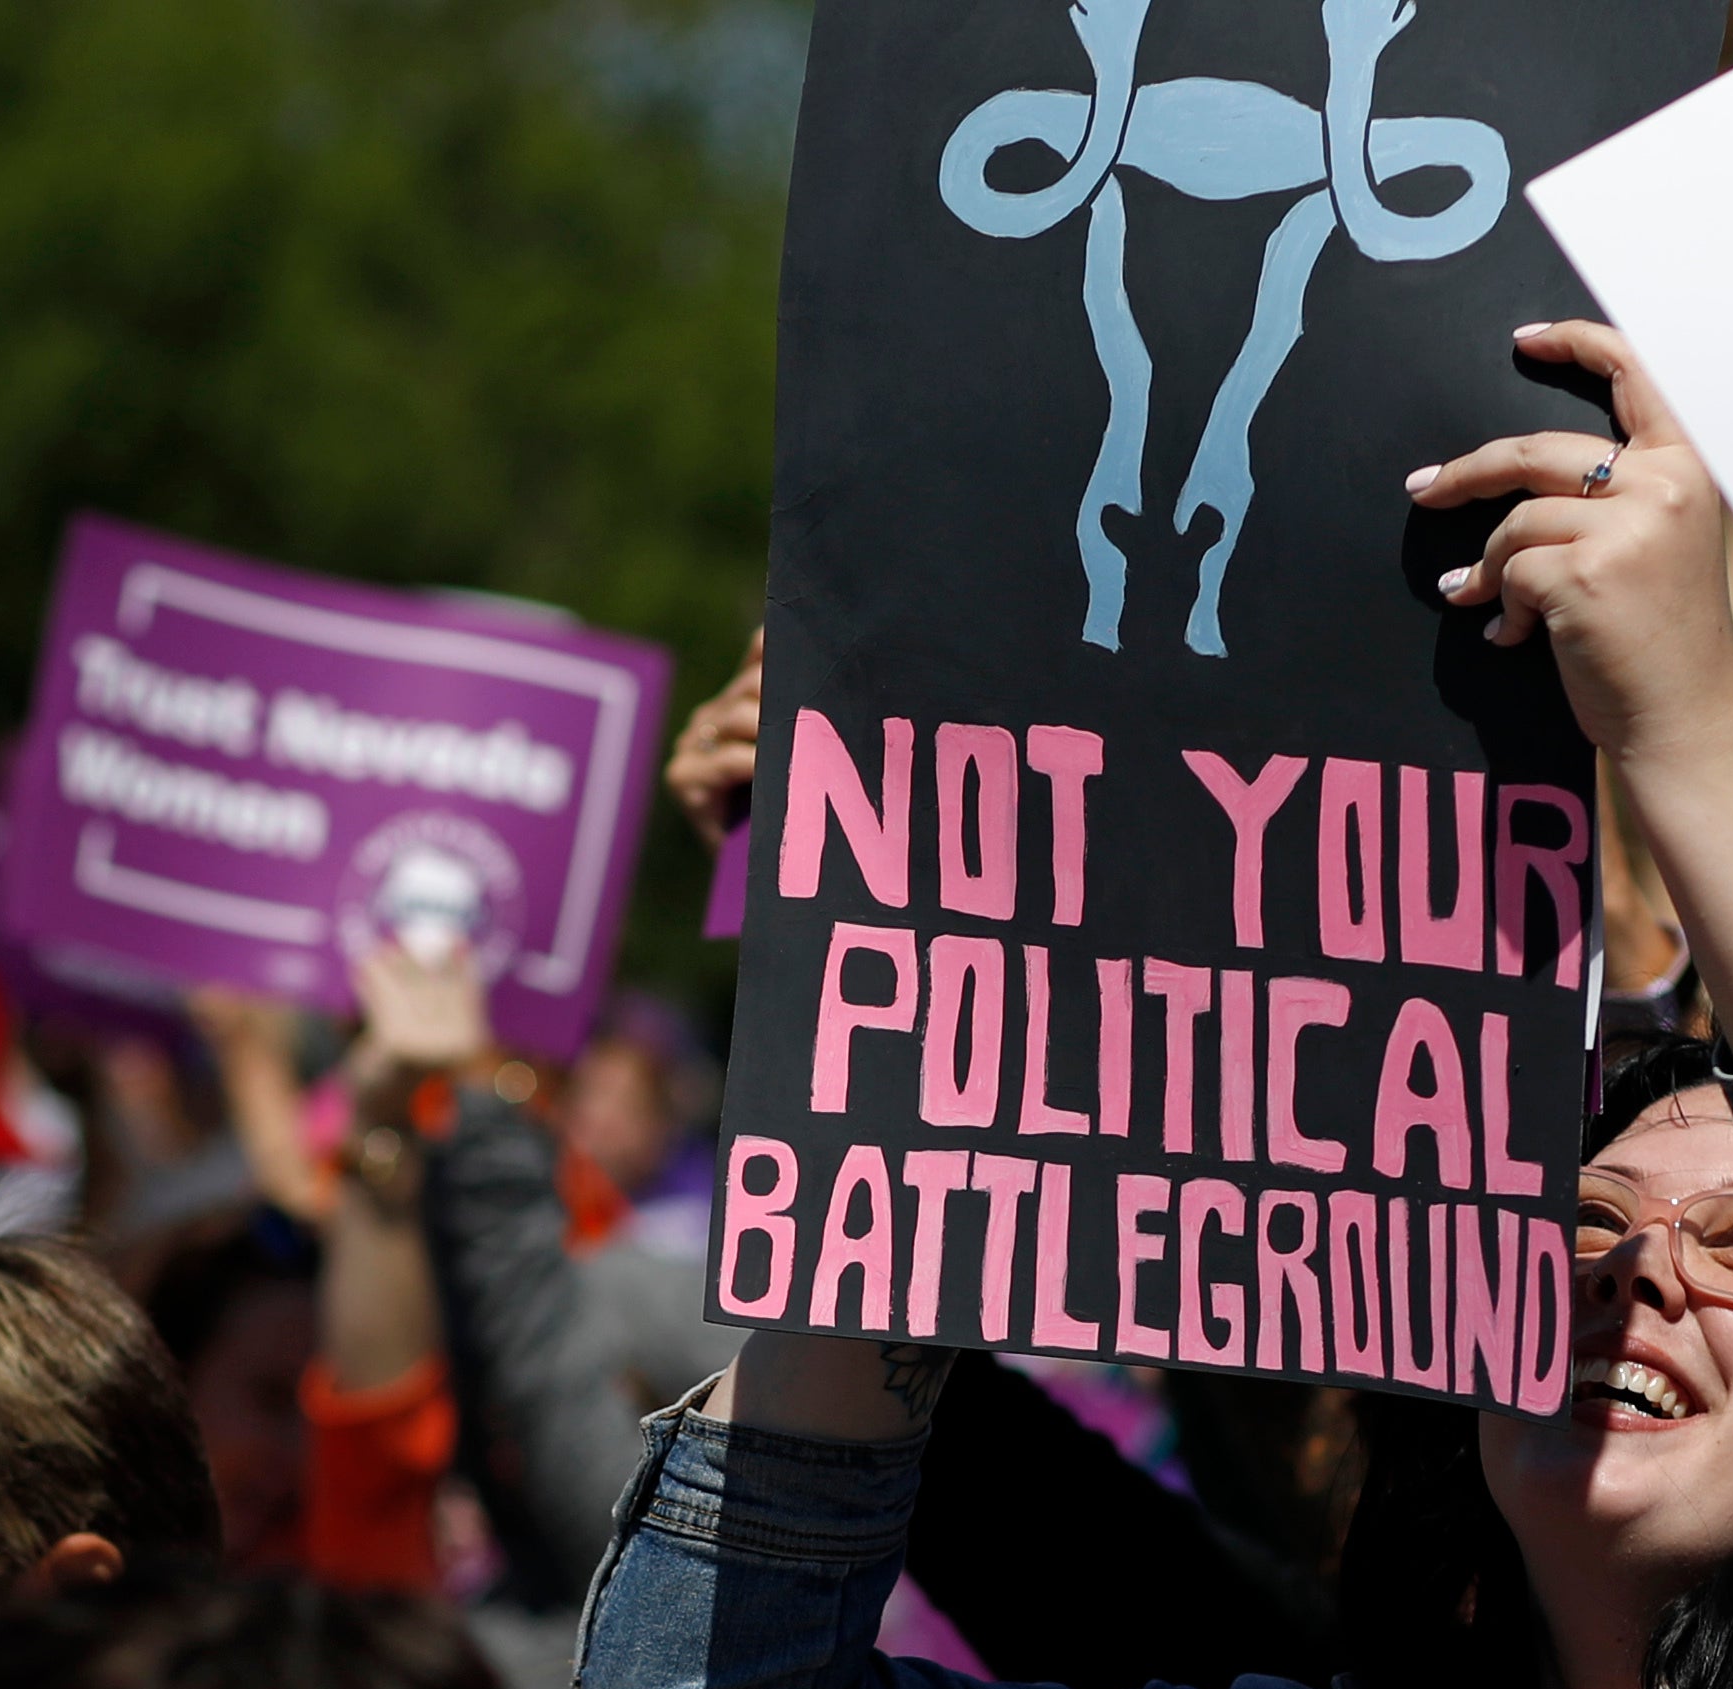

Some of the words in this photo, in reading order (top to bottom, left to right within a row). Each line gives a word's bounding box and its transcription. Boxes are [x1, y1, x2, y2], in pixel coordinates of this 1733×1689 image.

[60, 723, 331, 863] Women
[71, 633, 261, 757] Trust
[266, 686, 574, 815] Nevada
[778, 705, 1104, 927] NOT
[1182, 749, 1590, 990] YOUR
[810, 921, 1543, 1196] POLITICAL
[718, 1135, 1572, 1417] BATTLEGROUND
